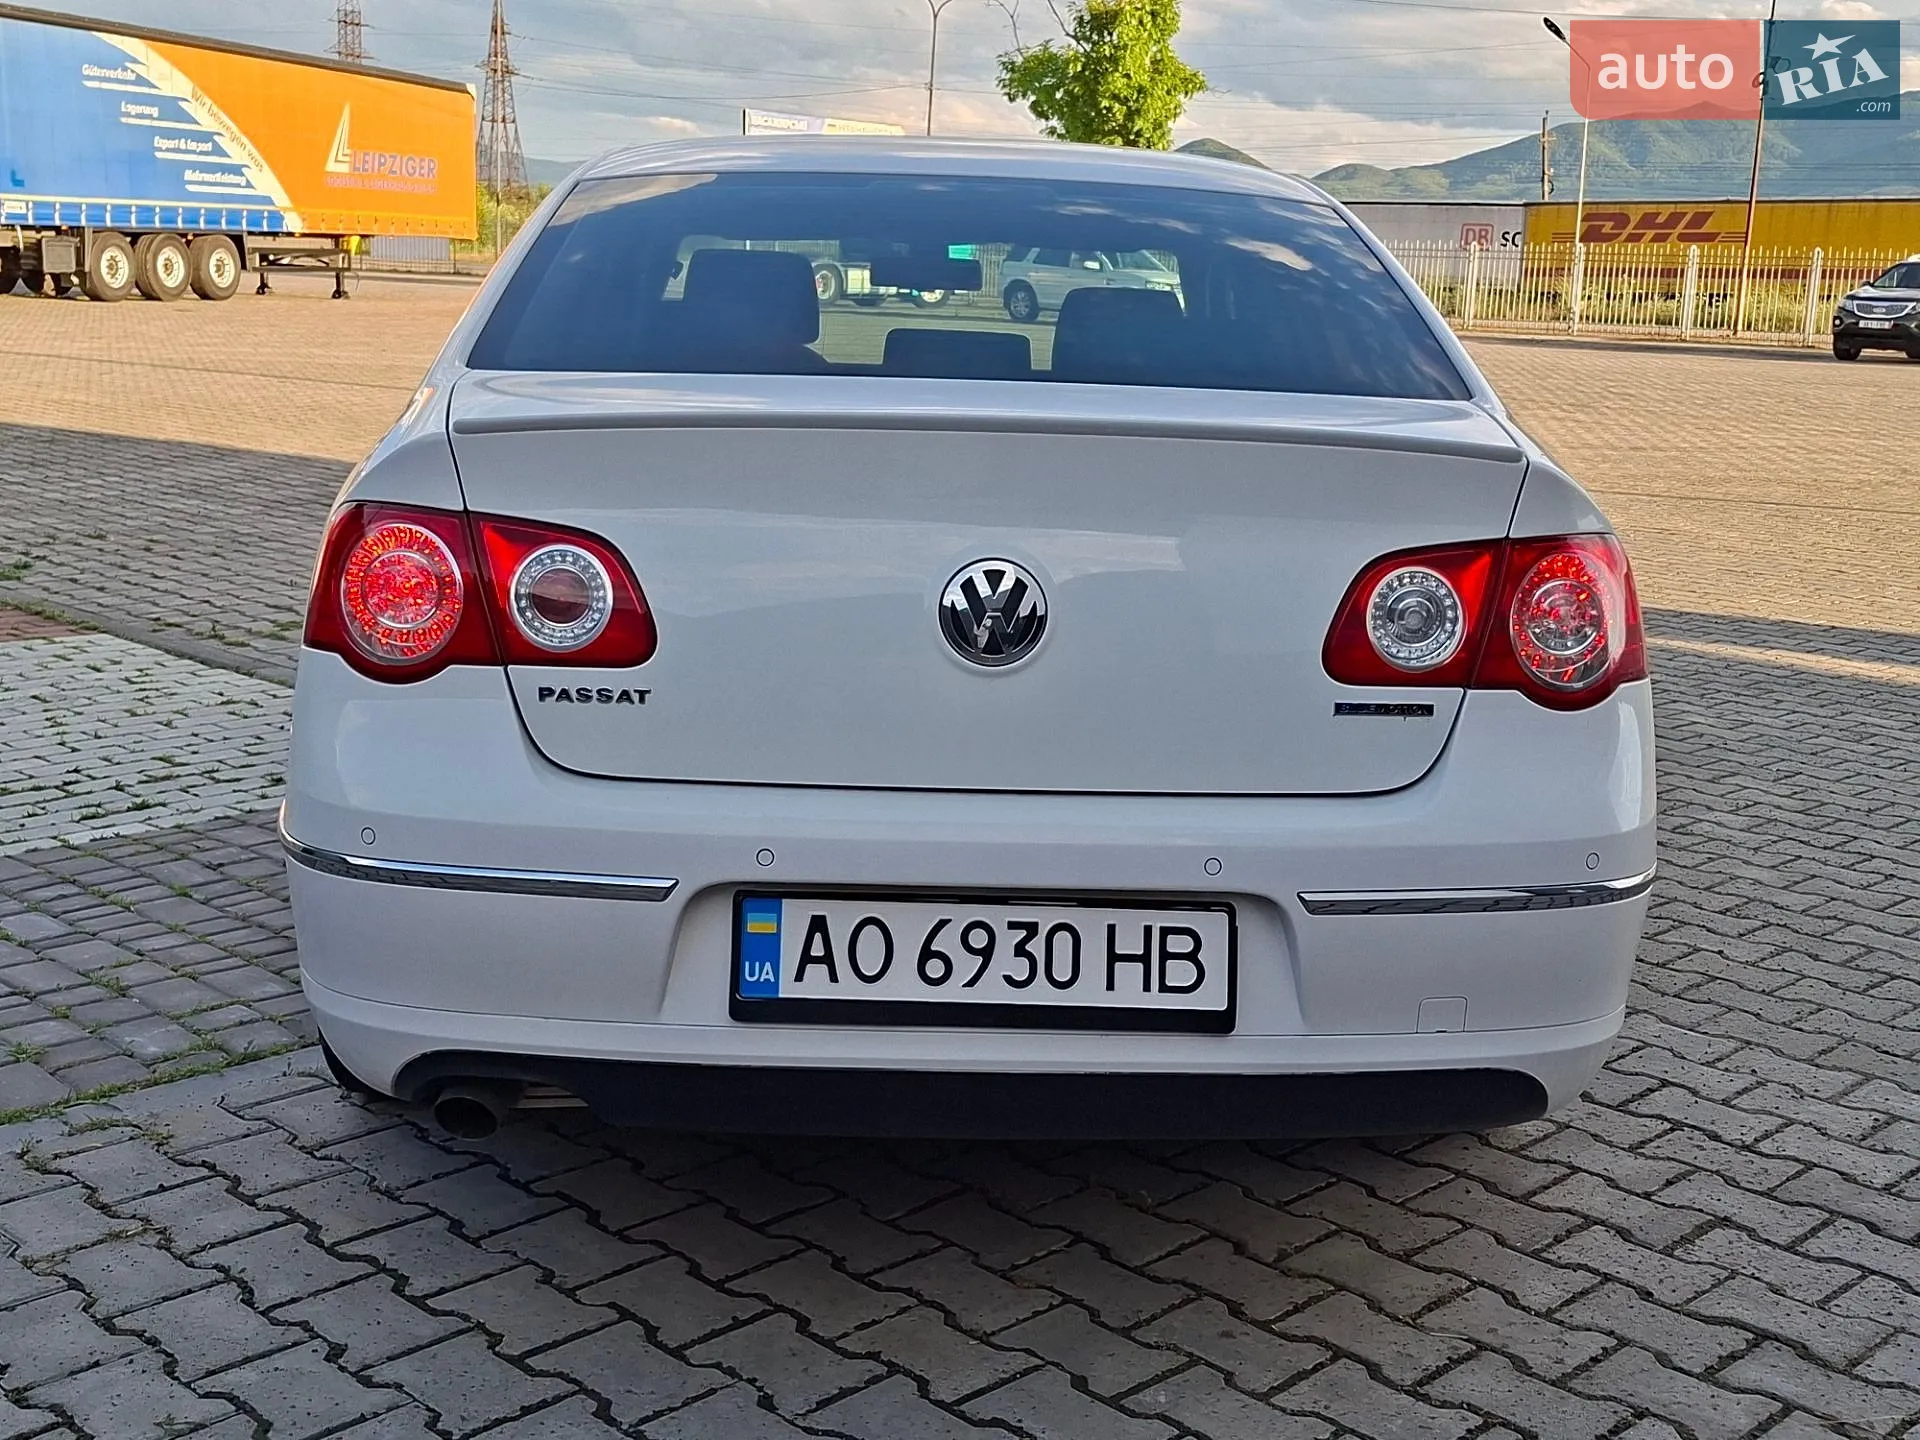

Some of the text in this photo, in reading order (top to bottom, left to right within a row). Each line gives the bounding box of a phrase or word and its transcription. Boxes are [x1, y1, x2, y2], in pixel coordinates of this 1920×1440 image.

[352, 150, 437, 180] LEIPZIGER
[1580, 211, 1721, 243] DHL
[538, 686, 652, 705] PASSAT
[794, 914, 1206, 994] AO 6930 HB
[744, 961, 775, 983] UA
